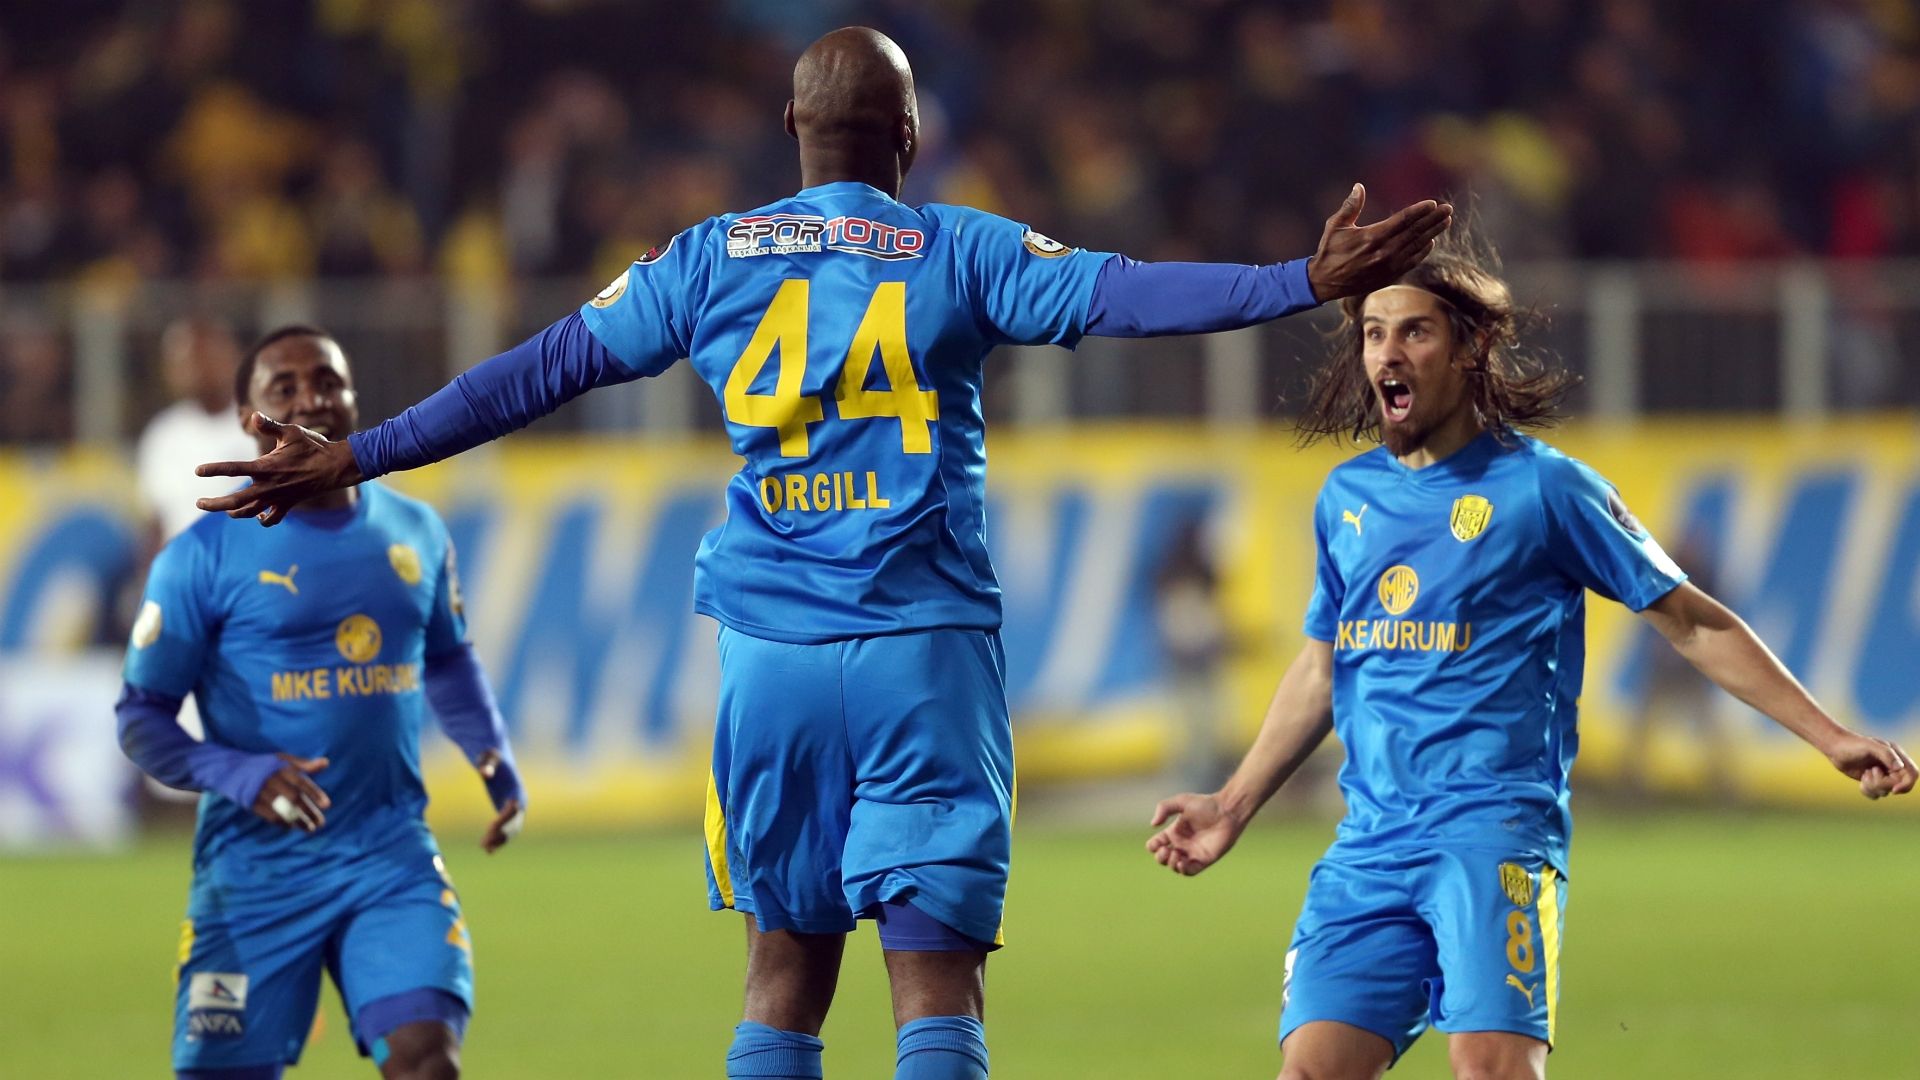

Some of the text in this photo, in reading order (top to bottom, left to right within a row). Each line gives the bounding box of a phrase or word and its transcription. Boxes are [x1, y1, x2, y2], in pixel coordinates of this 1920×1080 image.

[723, 278, 938, 457] 44
[760, 471, 890, 514] ORGILL
[1334, 619, 1471, 652] KE KURUMU
[272, 662, 421, 702] MKE KURUM
[1506, 910, 1535, 974] 8
